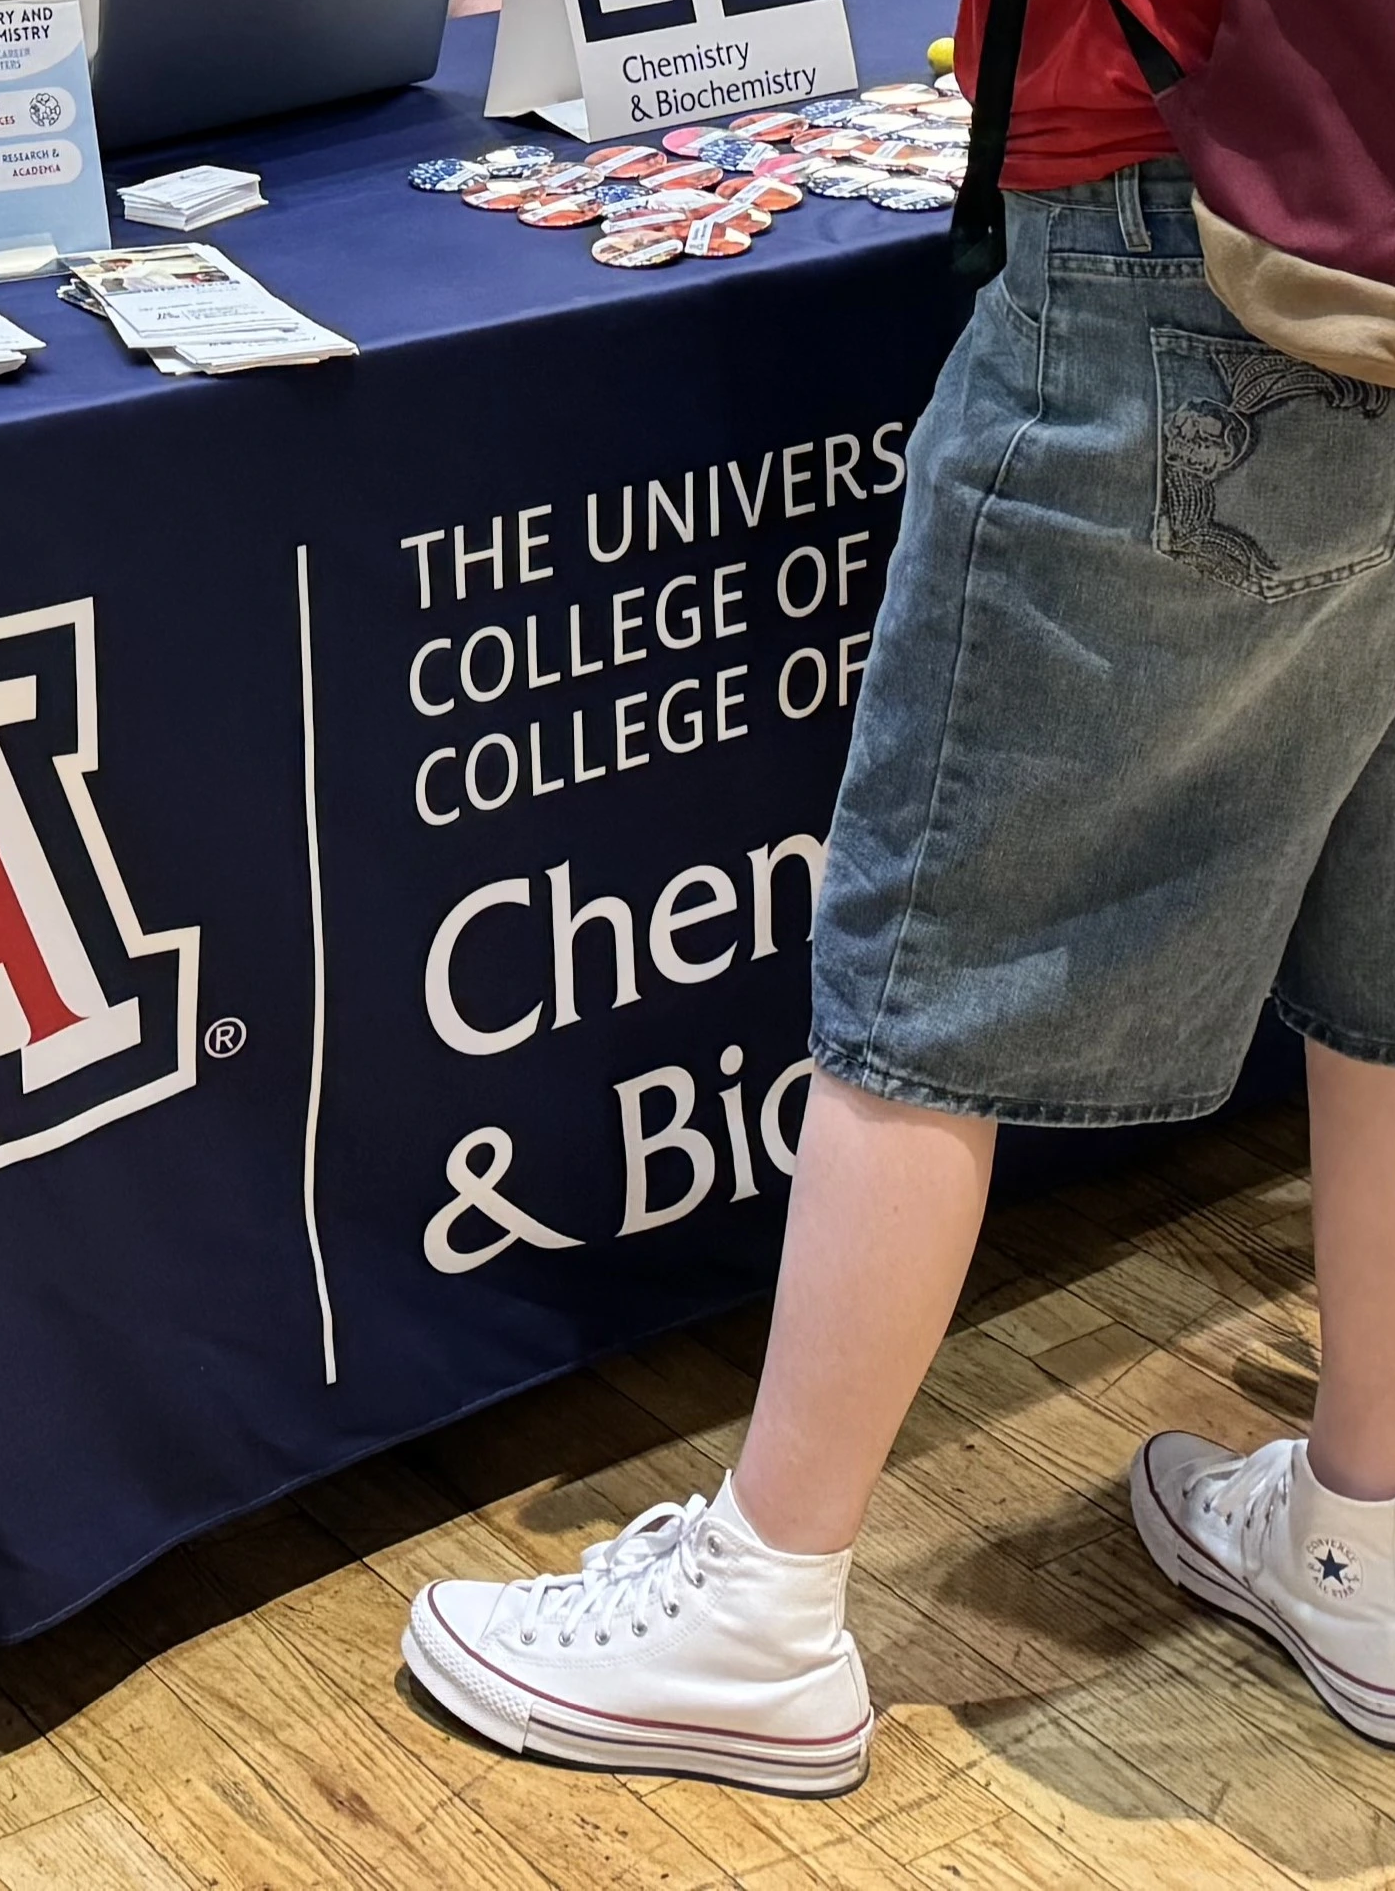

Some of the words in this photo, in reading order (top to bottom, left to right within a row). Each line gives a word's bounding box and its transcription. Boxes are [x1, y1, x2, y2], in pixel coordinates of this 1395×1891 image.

[21, 7, 53, 23] AND
[622, 42, 749, 83] Chemistry
[631, 94, 654, 122] &
[656, 67, 816, 117] Biochemistry
[2, 149, 49, 162] RESEARCH
[12, 164, 61, 177] ACADEMIA
[400, 504, 554, 609] THE
[586, 422, 905, 564] UNIVERS
[409, 561, 748, 717] COLLEGE
[776, 530, 871, 619] OF
[415, 664, 749, 827] COLLEGE
[777, 631, 871, 720] OF
[423, 1126, 586, 1275] &
